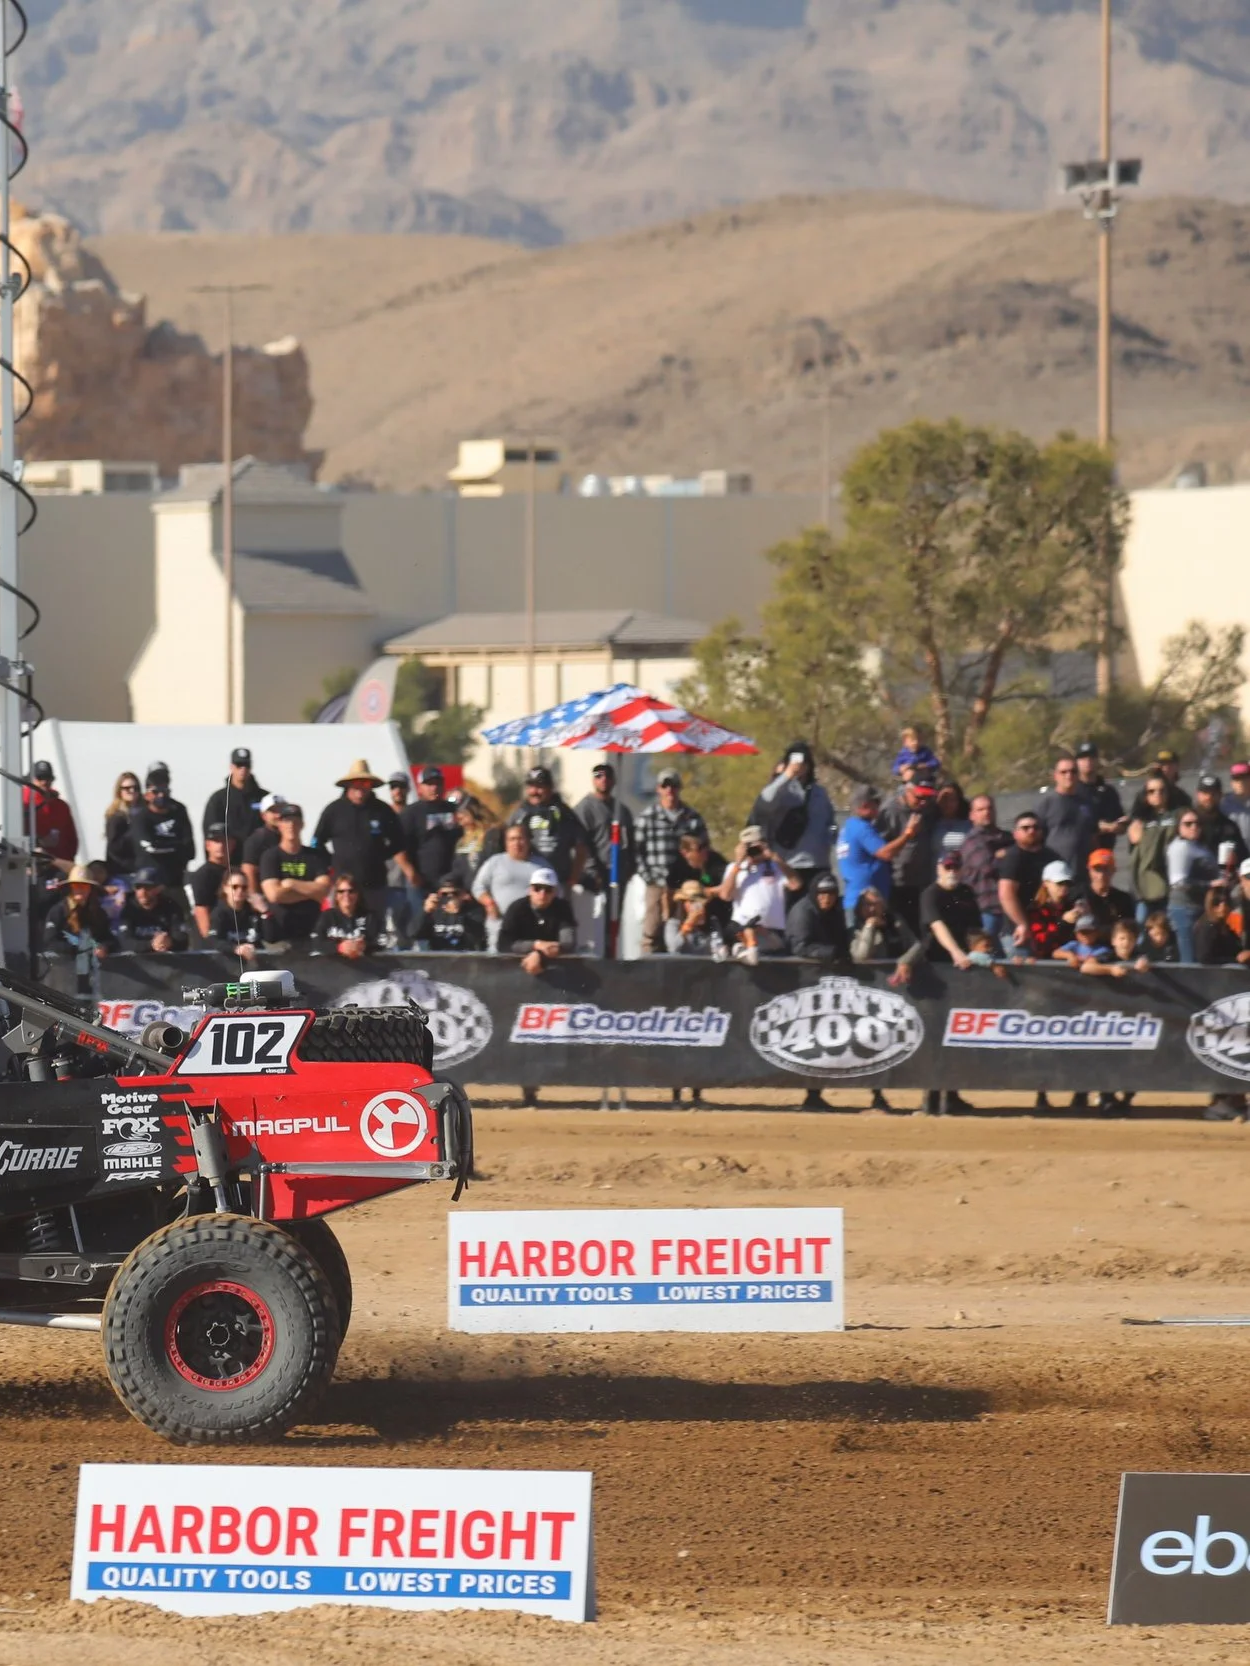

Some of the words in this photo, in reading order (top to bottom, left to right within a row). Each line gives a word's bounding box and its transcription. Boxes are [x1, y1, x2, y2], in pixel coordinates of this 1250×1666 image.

[518, 1006, 725, 1035] BFGoodrich
[781, 1013, 891, 1052] 400
[950, 1010, 1157, 1038] BFGoodrich
[210, 1022, 285, 1066] 102
[100, 1092, 159, 1105] Motive
[106, 1103, 152, 1115] Gear
[101, 1116, 160, 1139] FOX
[232, 1116, 350, 1138] MAGPUL
[103, 1156, 162, 1170] MAHLE
[458, 1240, 636, 1278] HARBOR
[651, 1237, 832, 1276] FREIGHT
[471, 1286, 559, 1303] QUALITY
[564, 1286, 634, 1302] TOOLS
[657, 1285, 742, 1301] LOWEST
[746, 1283, 822, 1300] PRICES
[87, 1504, 320, 1557] HARBOR
[337, 1508, 576, 1561] FREIGHT
[1140, 1515, 1250, 1576] eb
[102, 1567, 217, 1590] QUALITY
[224, 1569, 312, 1590] TOOLS
[344, 1572, 453, 1594] LOWEST
[459, 1574, 558, 1595] PRICES
